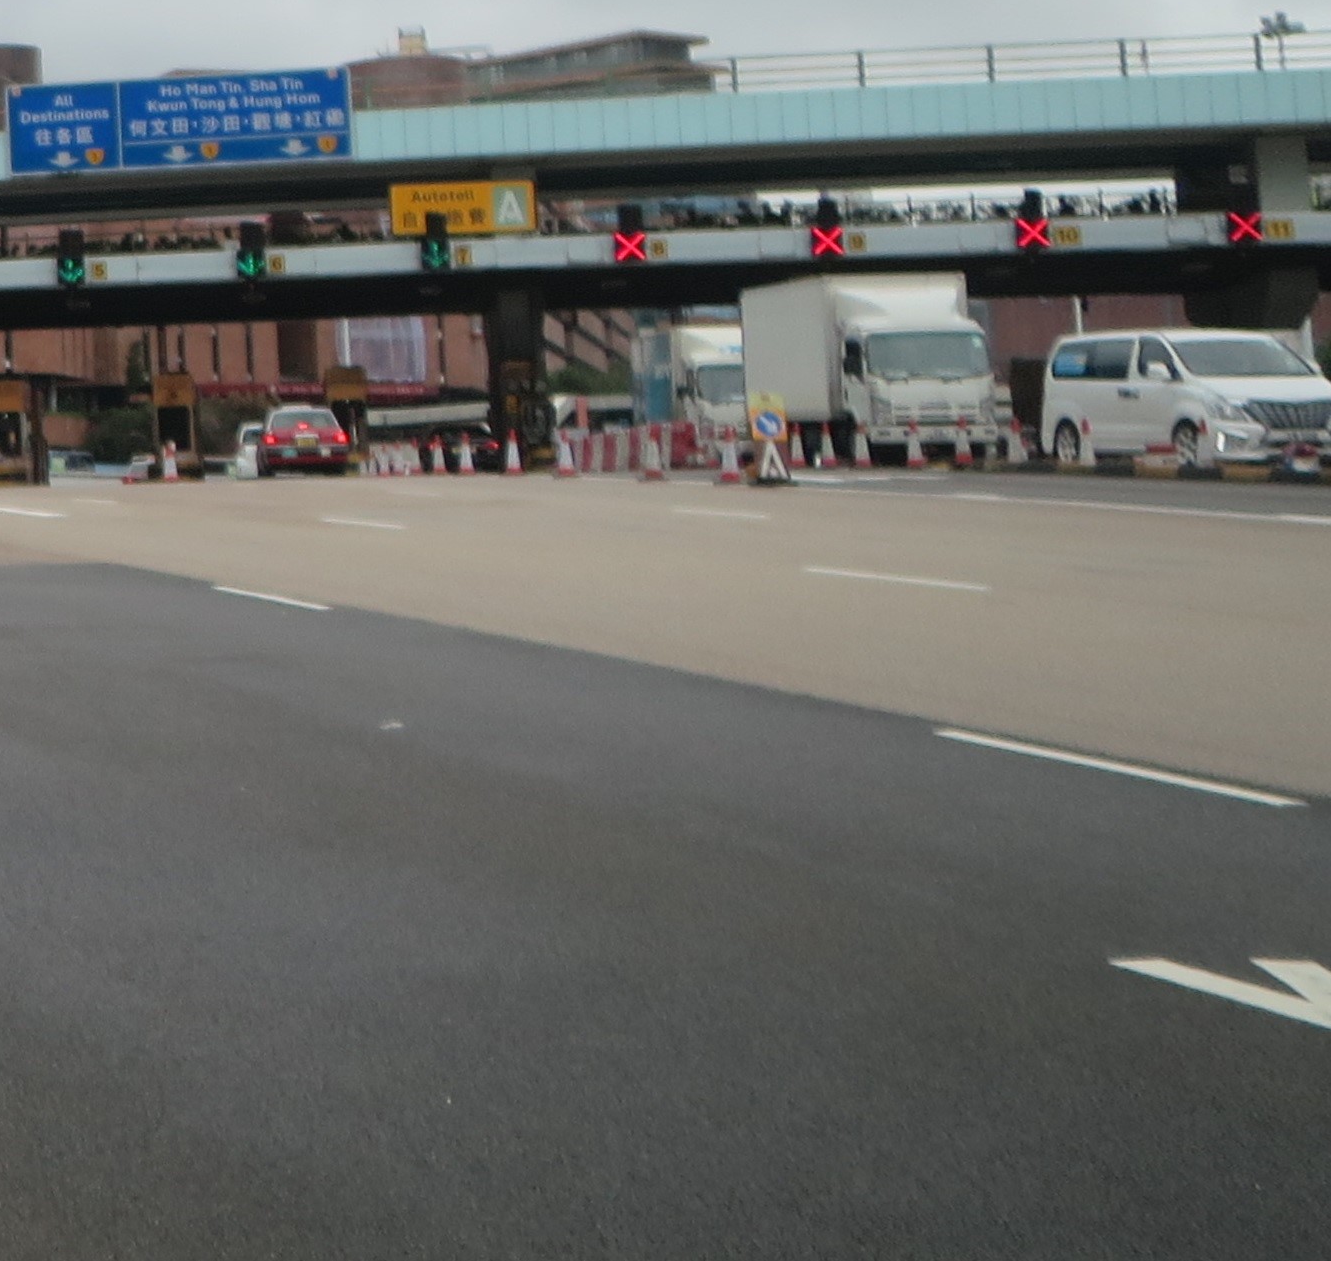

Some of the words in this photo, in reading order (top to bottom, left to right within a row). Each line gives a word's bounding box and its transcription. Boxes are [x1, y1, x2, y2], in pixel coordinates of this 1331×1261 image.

[161, 85, 181, 97] Ho
[185, 82, 217, 95] Man
[249, 79, 278, 92] Sha
[281, 78, 304, 90] Tin
[54, 94, 73, 107] All
[147, 100, 187, 112] Kwun
[191, 98, 225, 111] Tong
[229, 96, 239, 108] &
[244, 95, 283, 108] Hung
[287, 93, 321, 105] Hom
[20, 108, 109, 123] Destinations
[411, 190, 475, 204] Autotoll
